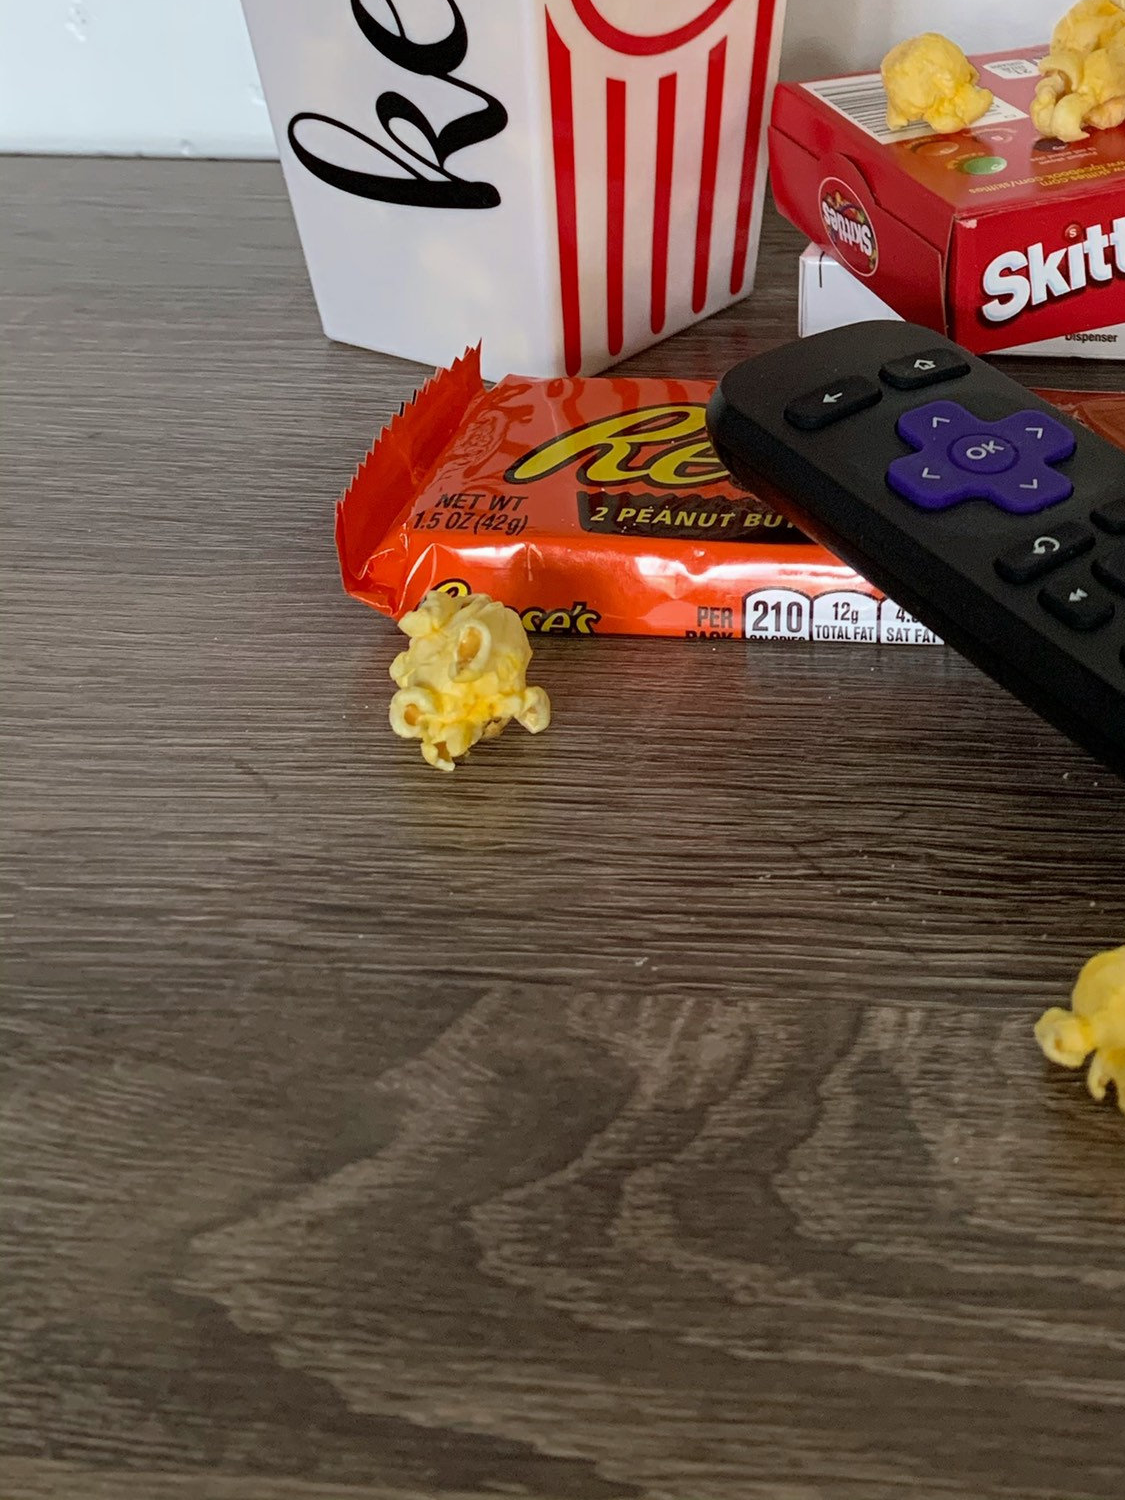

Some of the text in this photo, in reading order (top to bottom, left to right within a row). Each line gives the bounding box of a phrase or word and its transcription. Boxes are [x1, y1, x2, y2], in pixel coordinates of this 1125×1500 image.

[966, 440, 1005, 460] OK
[435, 493, 529, 512] NET WT
[413, 511, 443, 530] 1.5
[445, 512, 476, 530] OZ
[590, 506, 794, 528] 2 PEANUT BU
[697, 606, 733, 629] PER
[752, 600, 803, 633] 210
[833, 602, 859, 624] 12g
[815, 624, 875, 642] TOTAL FAT
[886, 626, 911, 642] SAT
